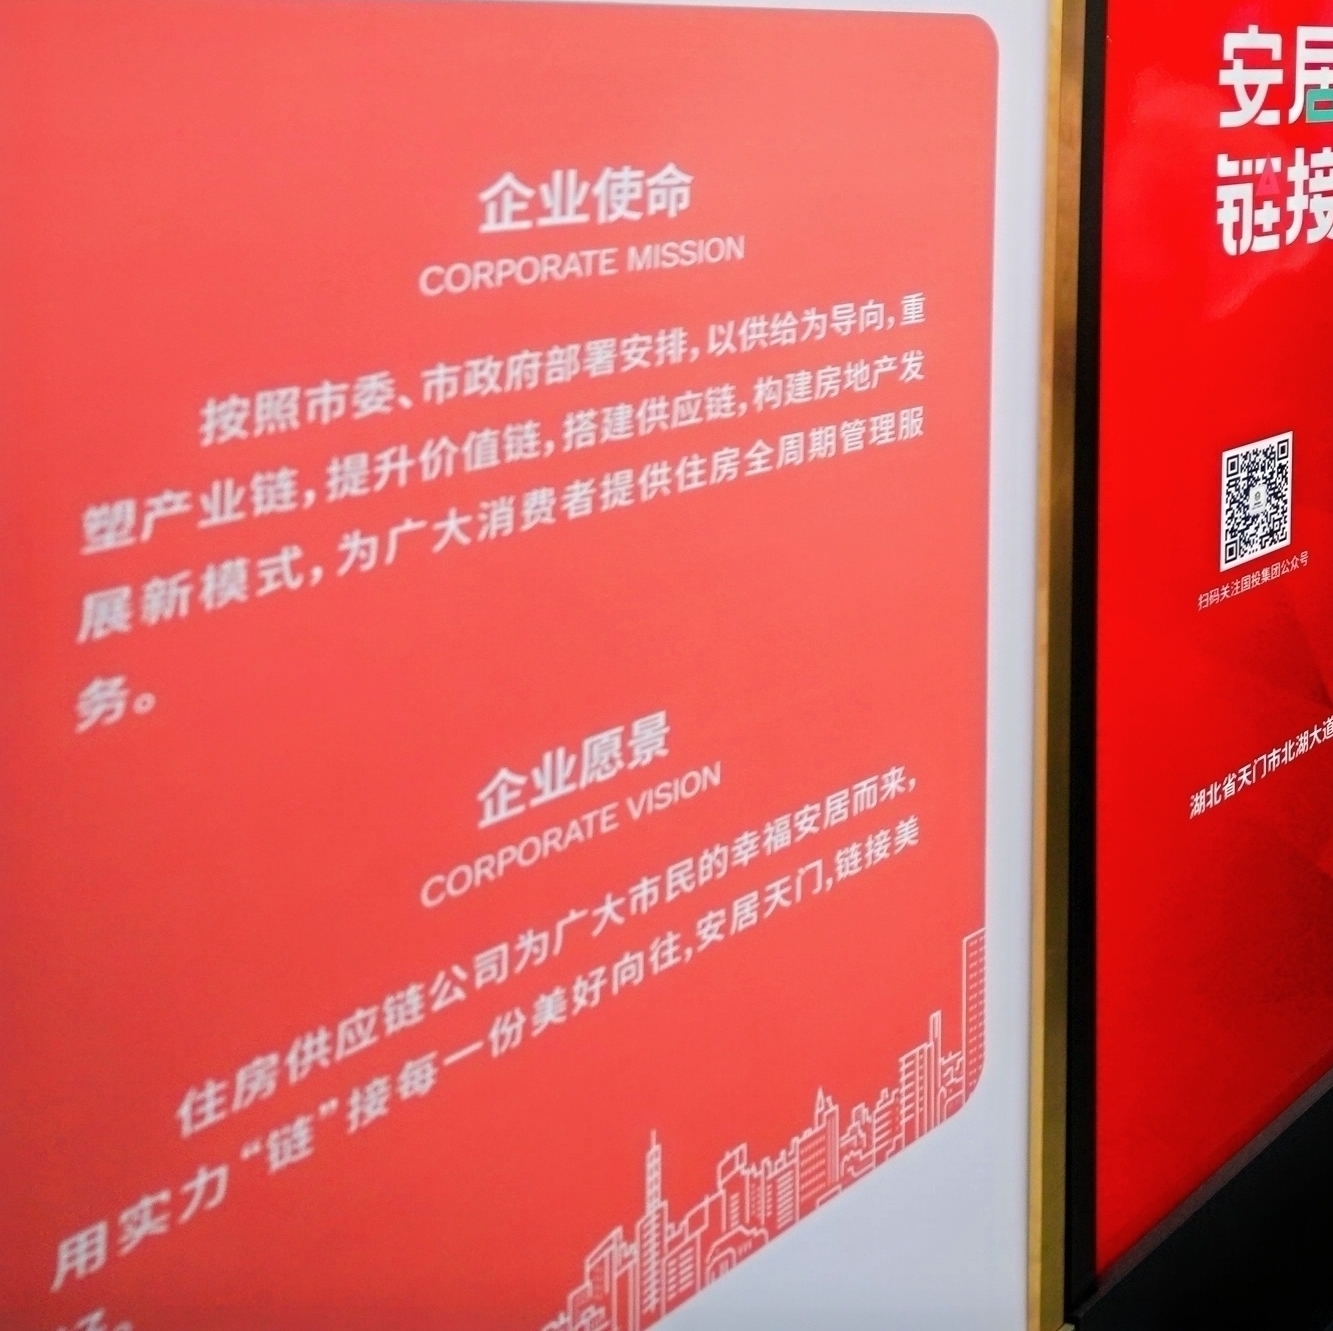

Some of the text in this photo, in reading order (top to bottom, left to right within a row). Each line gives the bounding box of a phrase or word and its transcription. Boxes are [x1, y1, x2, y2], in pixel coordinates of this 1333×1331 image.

[479, 163, 694, 234] 企业使命
[420, 236, 746, 296] CORPORATE MISSION
[200, 292, 926, 447] 按照市委、市政府部署安排，以供给为导向，重
[81, 349, 925, 555] 塑产业链，提升价值链，搭建供应链，构建房地产发
[76, 406, 925, 644] 展新模式，为广大消费者提供住房全周期管理服
[1197, 550, 1309, 611] 扫码关注国投集团公众号
[75, 675, 155, 734] 务。
[477, 709, 670, 830] 企业愿景
[420, 762, 721, 909] CORPORATE VISION
[176, 765, 916, 1139] 住房供应链公司为广大市民的幸福安居而来，
